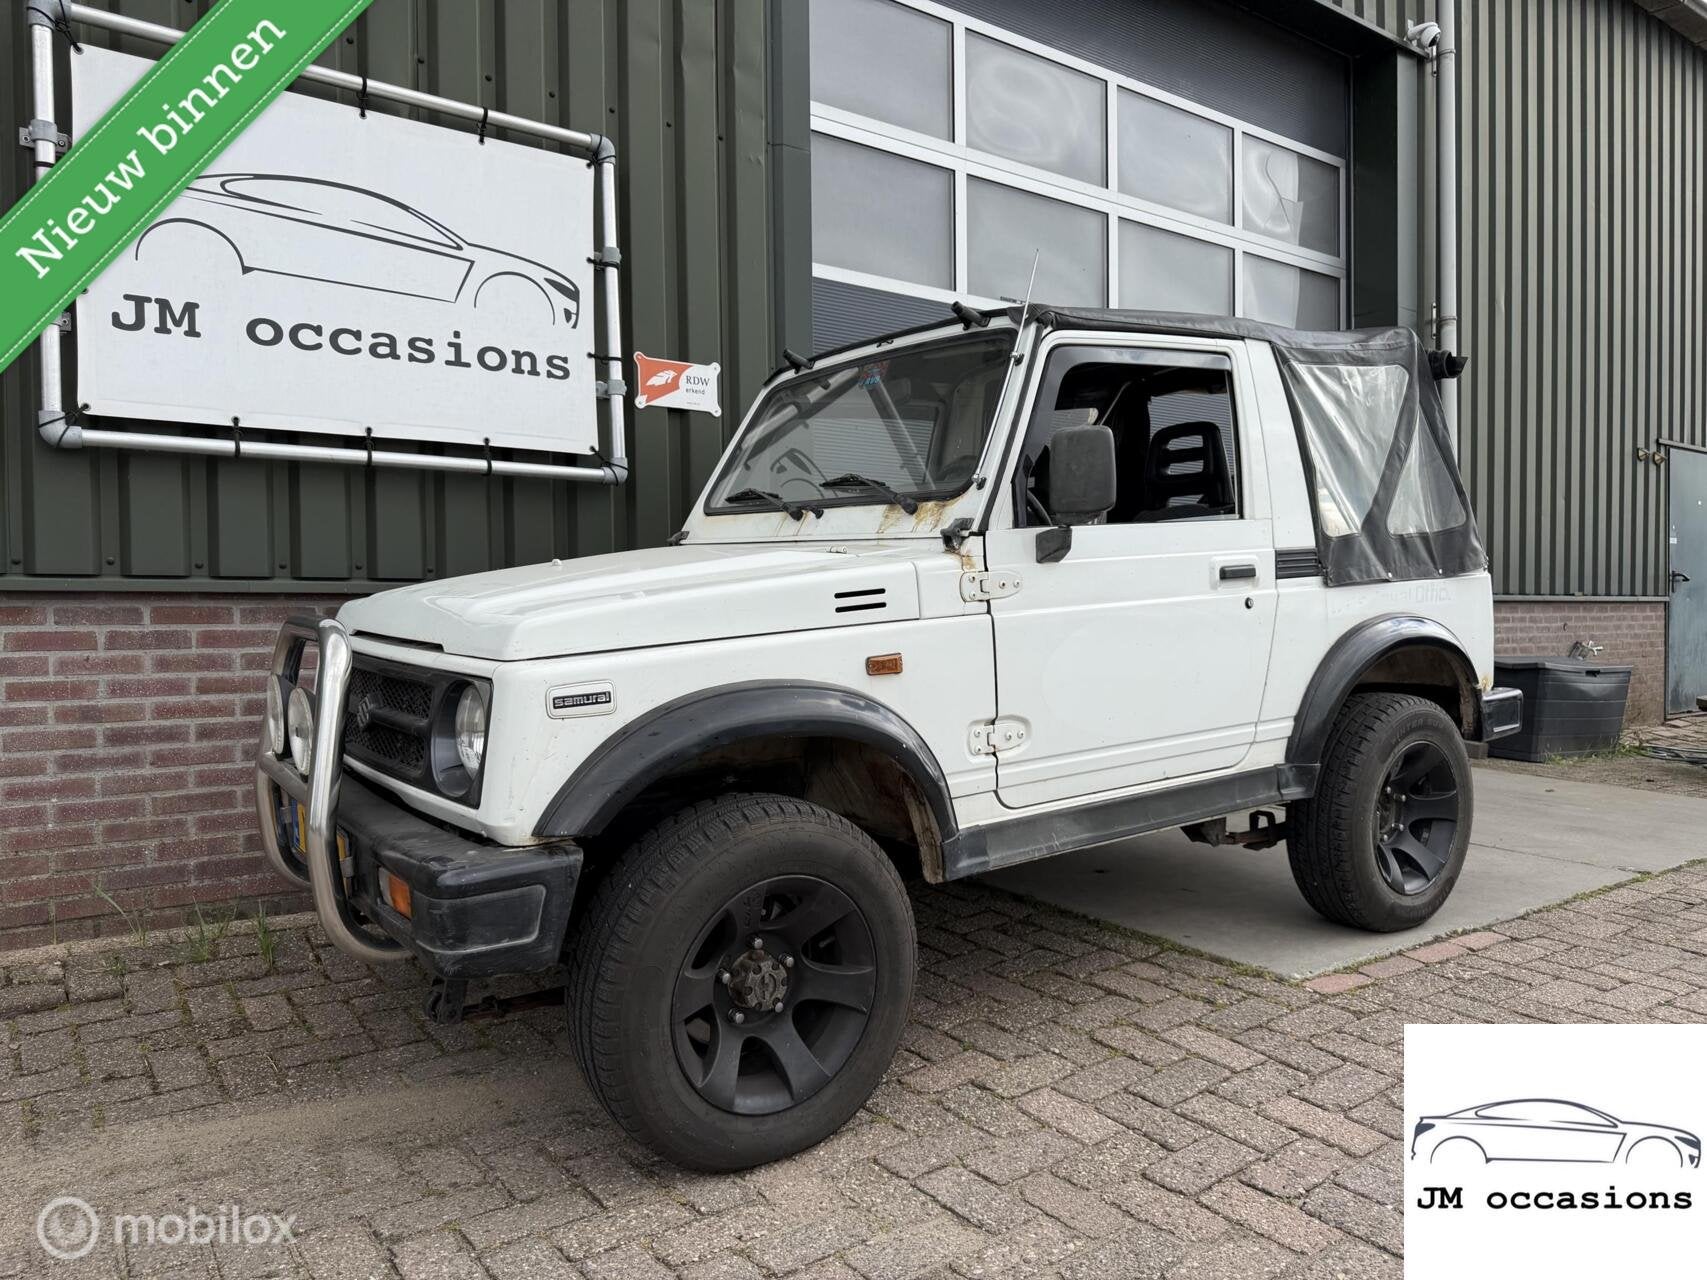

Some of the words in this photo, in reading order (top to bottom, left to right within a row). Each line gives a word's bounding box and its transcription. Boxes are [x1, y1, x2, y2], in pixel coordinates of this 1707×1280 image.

[111, 293, 202, 338] JM
[246, 317, 570, 380] occasions
[685, 375, 710, 386] RDW
